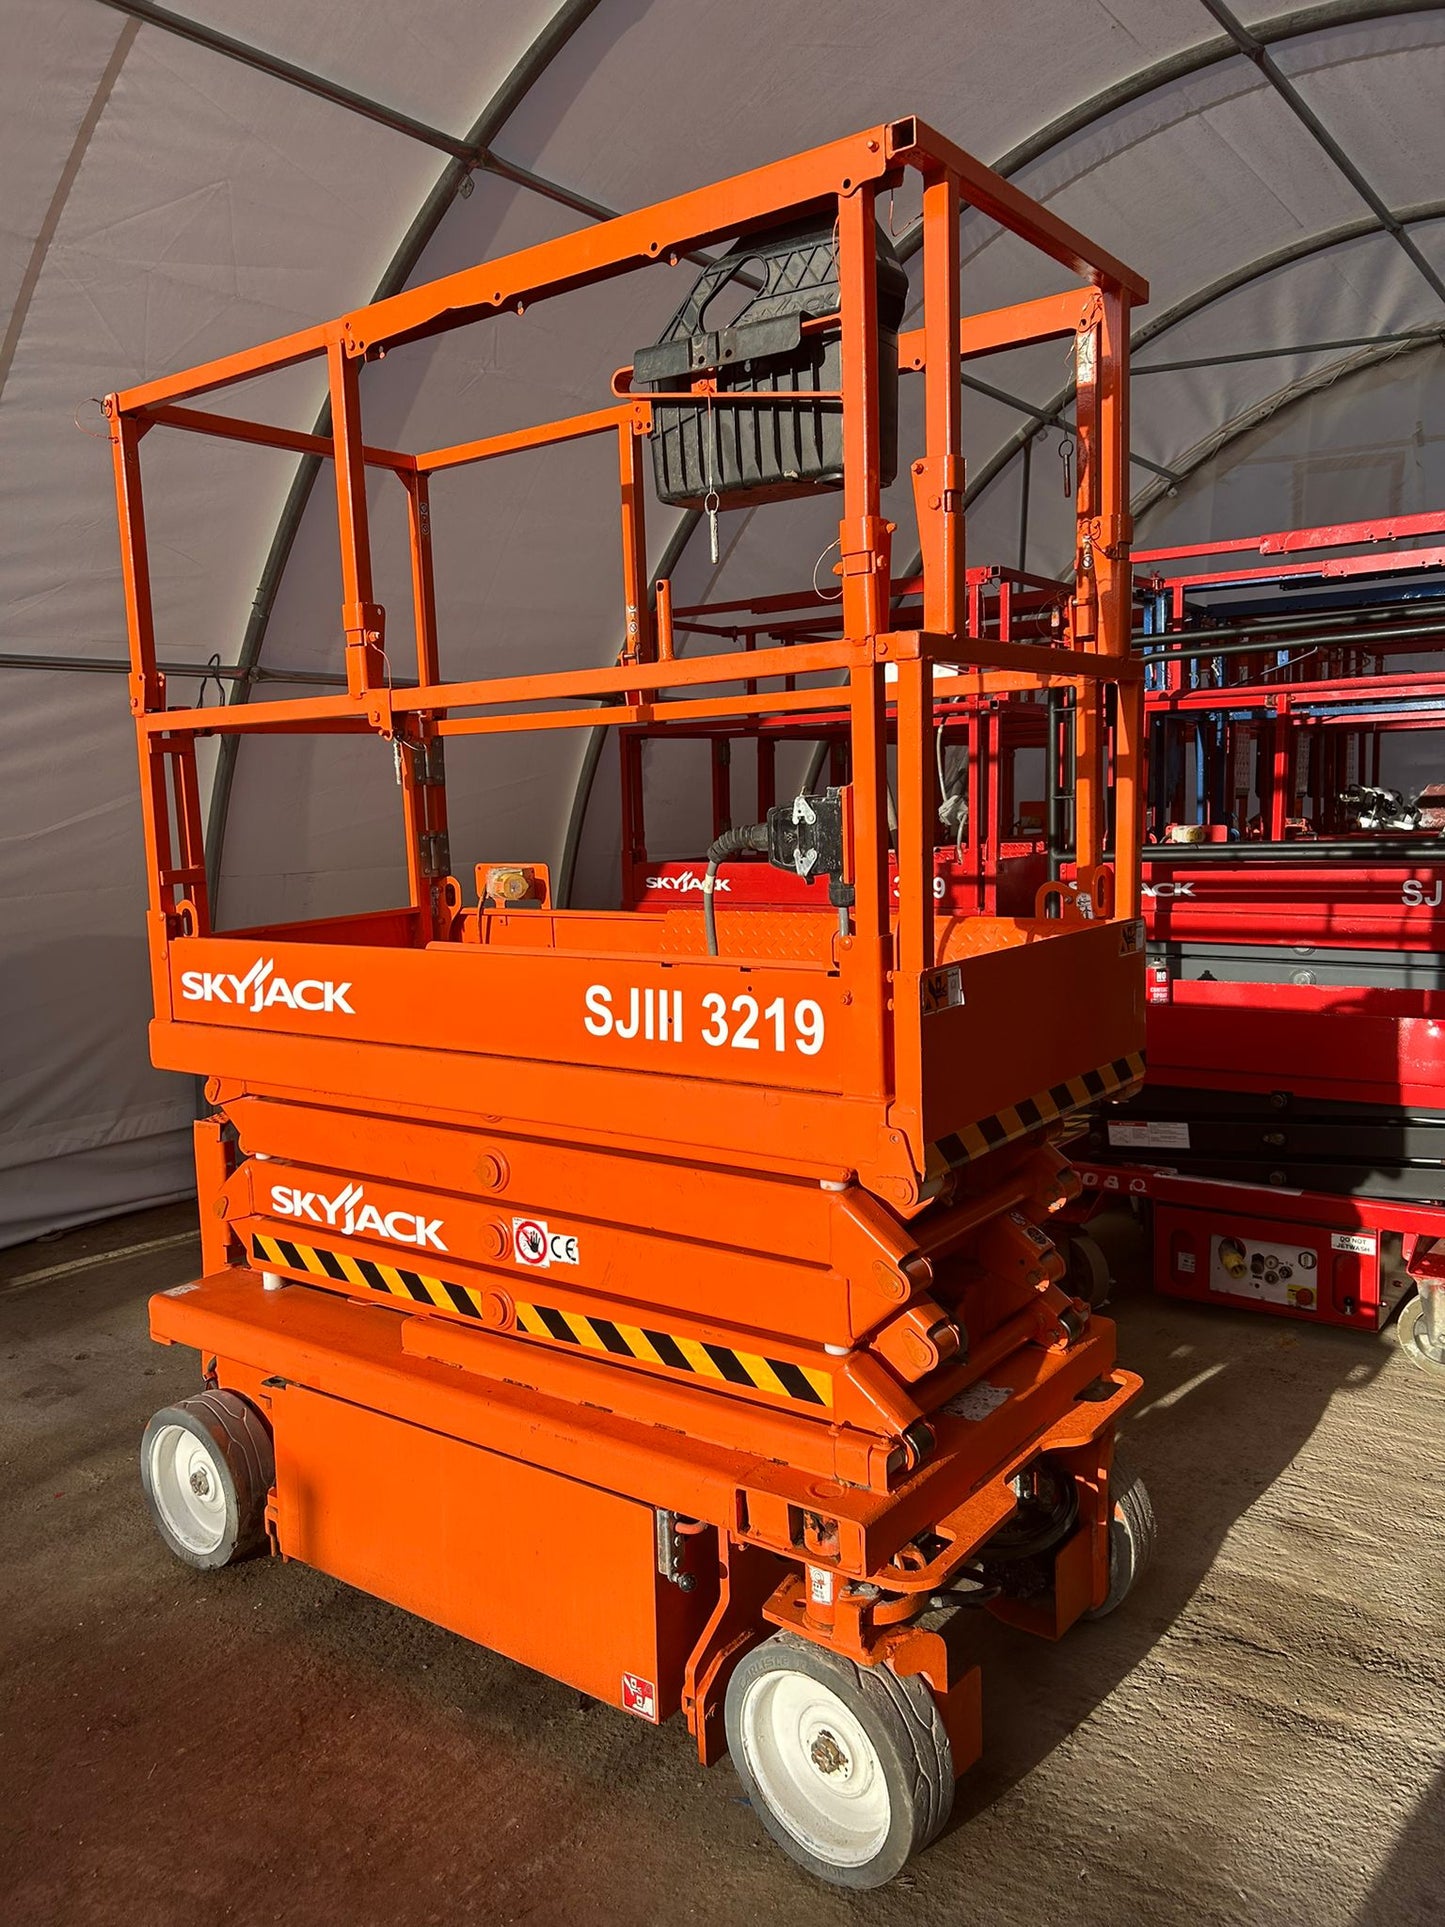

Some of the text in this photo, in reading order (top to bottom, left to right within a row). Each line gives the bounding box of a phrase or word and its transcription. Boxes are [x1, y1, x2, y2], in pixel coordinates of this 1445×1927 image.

[181, 956, 356, 1014] SKYJACK
[583, 984, 825, 1056] SJIII 3219
[270, 1182, 449, 1252] SKYJACK
[1339, 1235, 1351, 1243] DO
